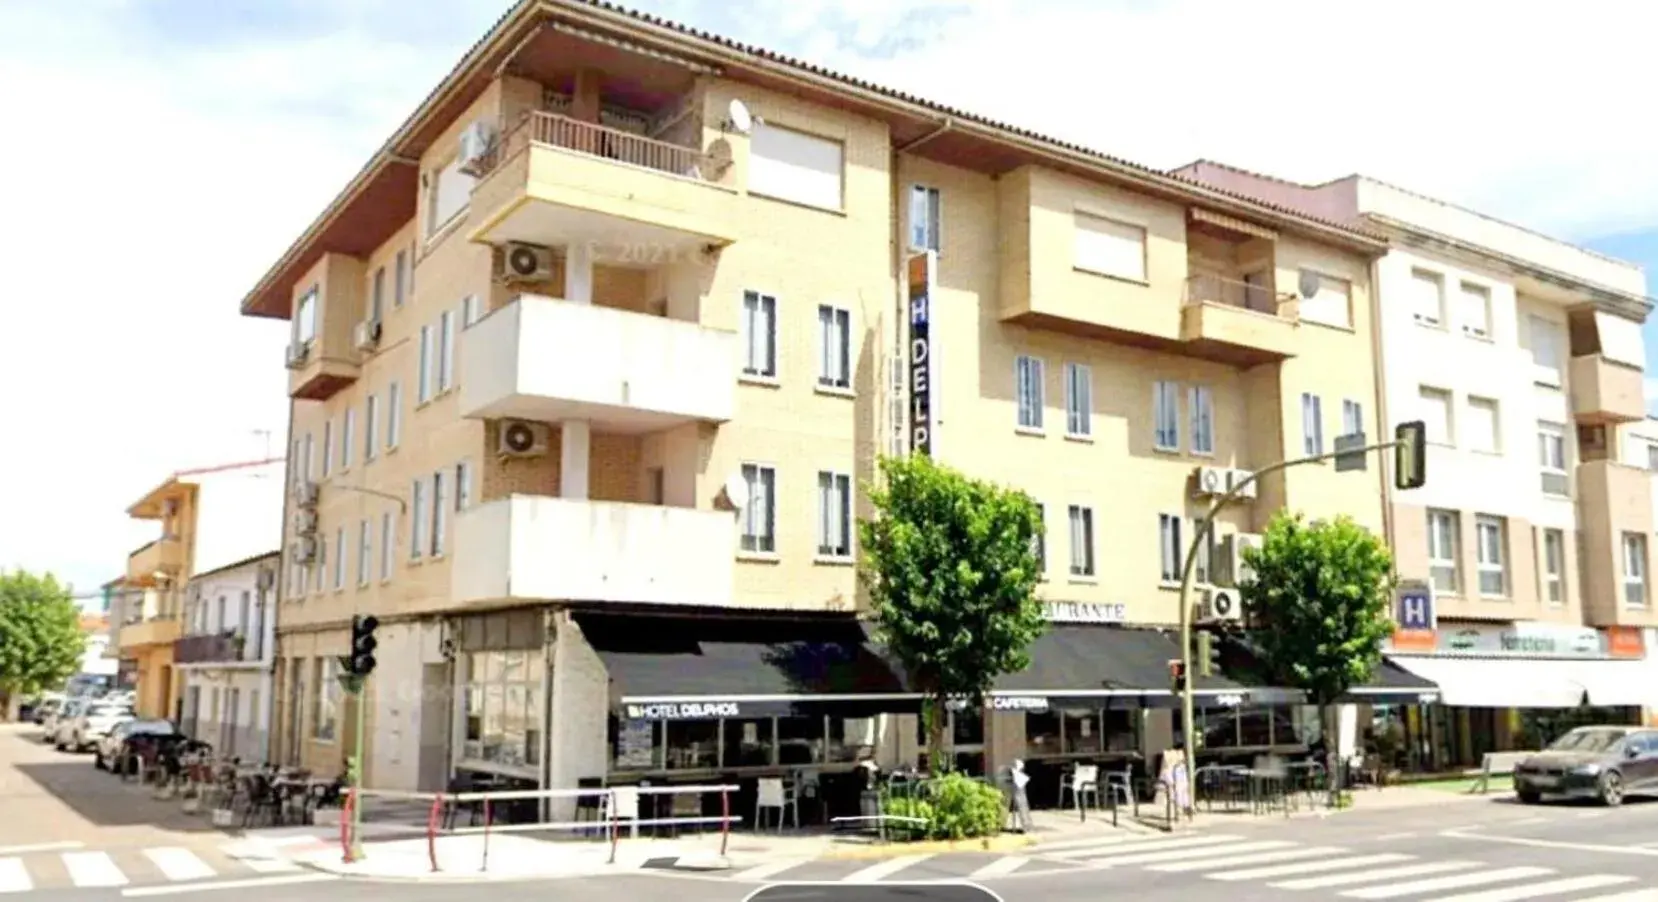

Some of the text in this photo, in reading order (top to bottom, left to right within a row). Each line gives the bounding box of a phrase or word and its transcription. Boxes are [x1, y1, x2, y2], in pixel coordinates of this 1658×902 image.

[911, 299, 927, 325] H
[911, 340, 928, 449] DELP
[1404, 597, 1425, 624] H
[643, 702, 739, 718] HOTEL DELPHOS
